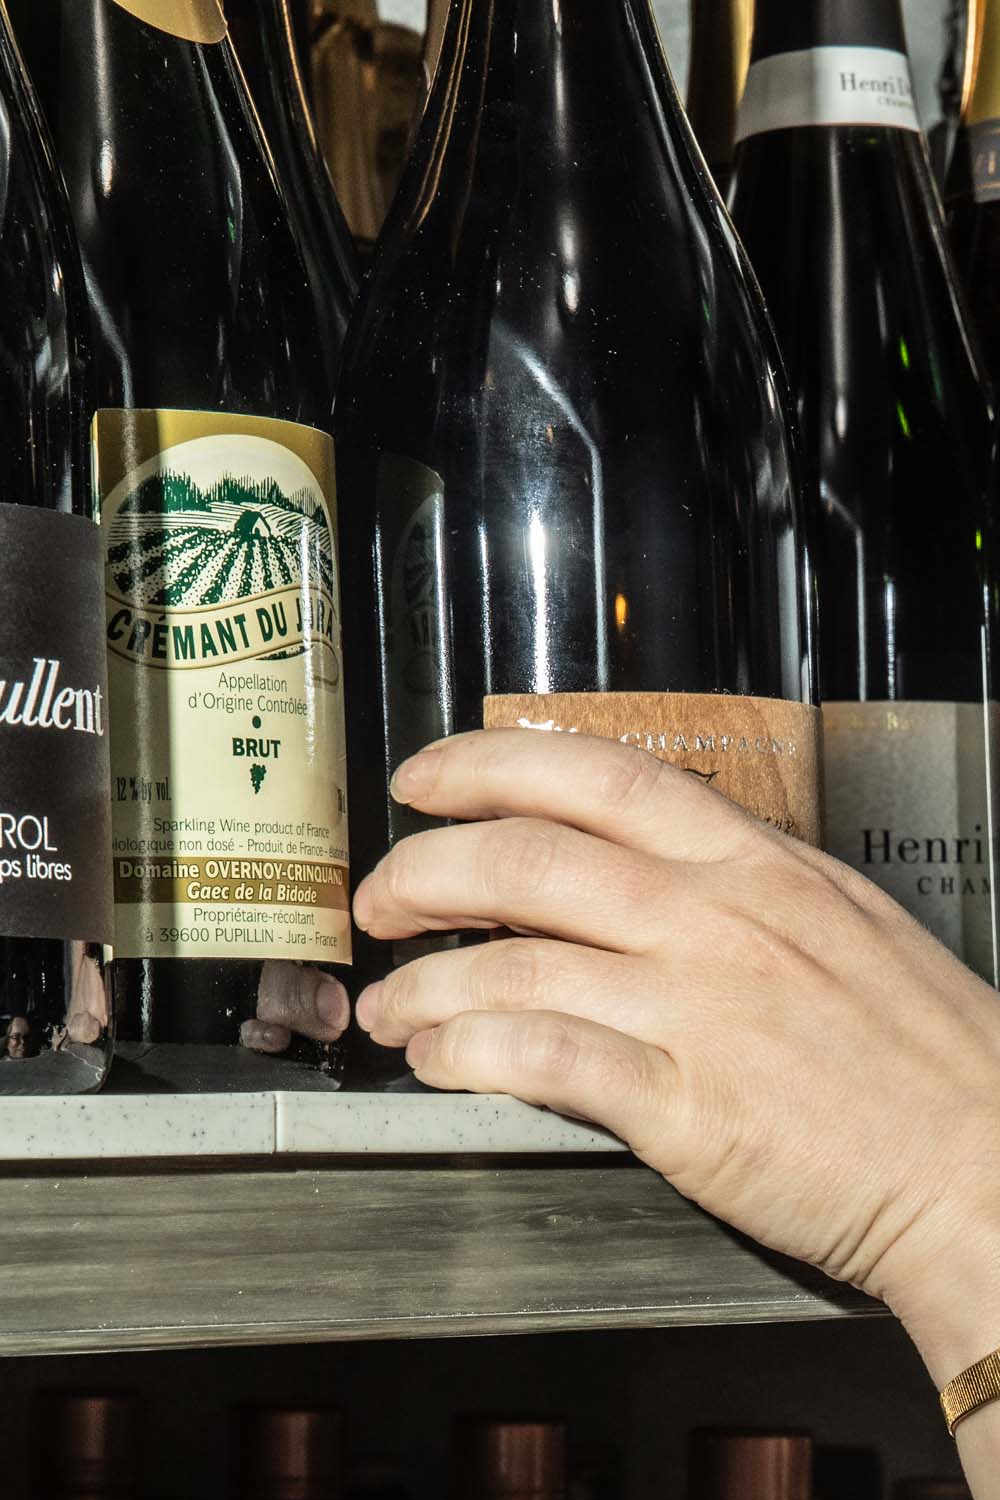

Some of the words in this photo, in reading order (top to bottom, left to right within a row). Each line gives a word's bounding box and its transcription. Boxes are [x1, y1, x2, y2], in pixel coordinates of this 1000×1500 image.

[107, 607, 250, 660] CRÉMANT
[256, 602, 288, 642] DU
[218, 672, 288, 693] Appellation
[188, 691, 254, 714] d'Origine
[257, 694, 309, 716] Contrôlée
[232, 737, 281, 759] BRUT
[116, 776, 127, 801] 12
[153, 817, 216, 835] Sparkling
[219, 818, 251, 833] Wine
[254, 820, 294, 837] product
[295, 822, 304, 836] of
[306, 823, 330, 840] France
[179, 840, 202, 852] non
[206, 837, 235, 852] dosé
[247, 838, 284, 853] Produit
[286, 840, 298, 854] de
[299, 842, 324, 856] France
[863, 823, 983, 865] Henri
[27, 853, 73, 881] libres
[119, 860, 200, 879] Domaine
[205, 860, 343, 887] OVERNOY-CRINQUAND
[187, 882, 230, 901] Gaec
[234, 883, 254, 901] de
[258, 883, 272, 901] la
[277, 884, 317, 904] Bidode
[193, 907, 316, 926] Propriétaire-récoltant
[146, 928, 154, 942] à
[159, 927, 210, 943] 39600
[215, 927, 274, 944] PUPILLIN
[285, 931, 307, 945] Jura
[315, 932, 338, 947] France
